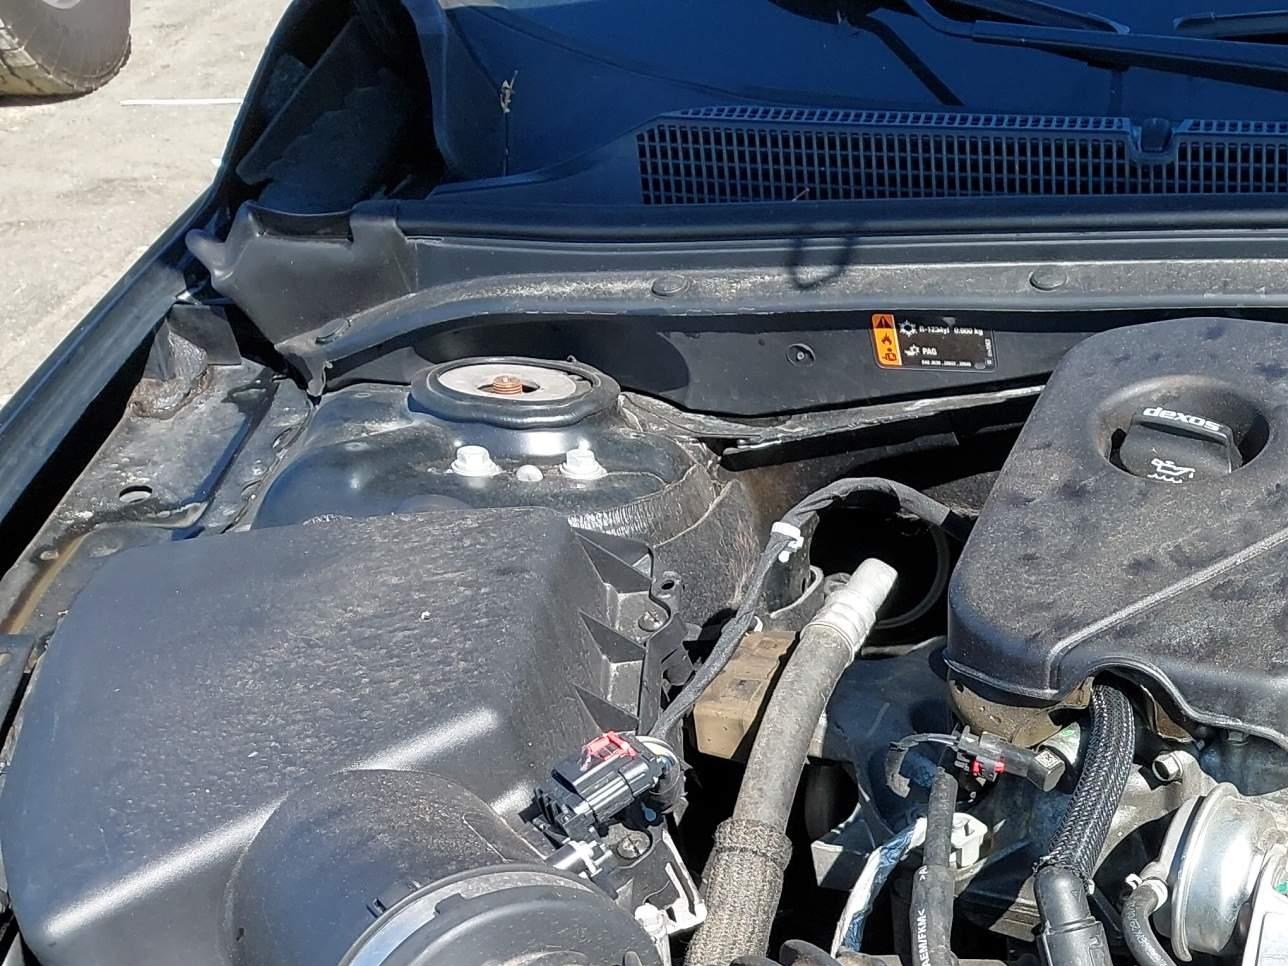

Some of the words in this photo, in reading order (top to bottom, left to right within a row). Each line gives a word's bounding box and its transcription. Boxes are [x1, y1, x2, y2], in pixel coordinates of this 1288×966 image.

[974, 328, 984, 336] kg
[922, 347, 937, 355] PAG
[1143, 407, 1220, 431] dexos
